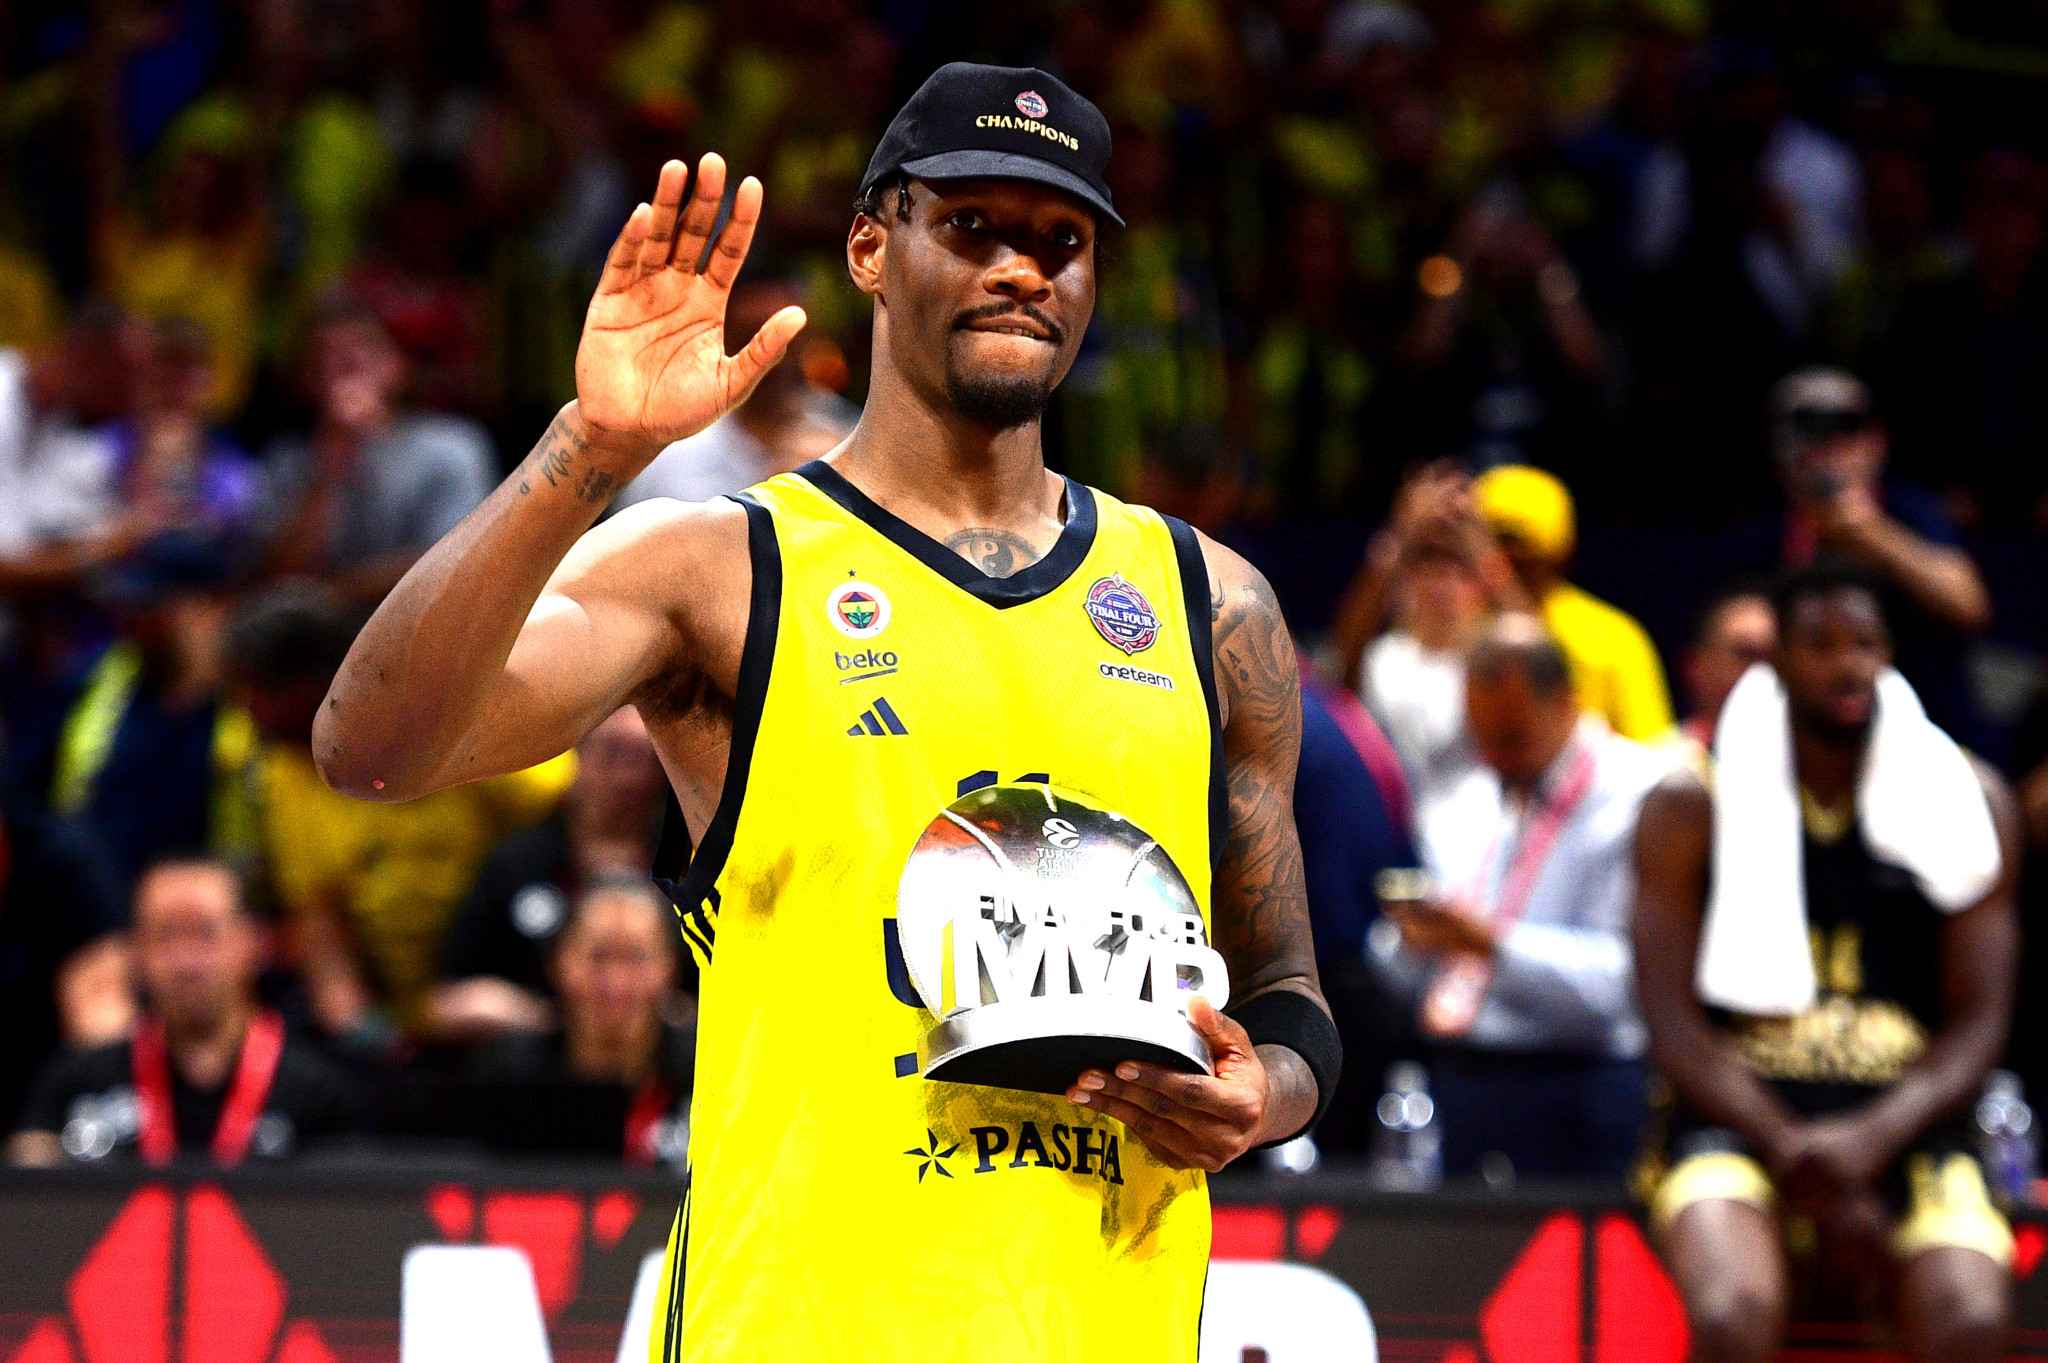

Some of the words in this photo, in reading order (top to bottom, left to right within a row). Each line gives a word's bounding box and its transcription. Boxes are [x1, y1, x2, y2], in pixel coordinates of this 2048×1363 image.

[976, 115, 1079, 151] CHAMPIONS
[1092, 603, 1122, 621] FINAL
[1122, 612, 1153, 627] FOUR
[834, 649, 899, 671] beko
[1036, 847, 1090, 863] TURKI
[1037, 858, 1091, 873] AIRLI
[973, 889, 1087, 936] FINA
[969, 1121, 1124, 1186] PASHA
